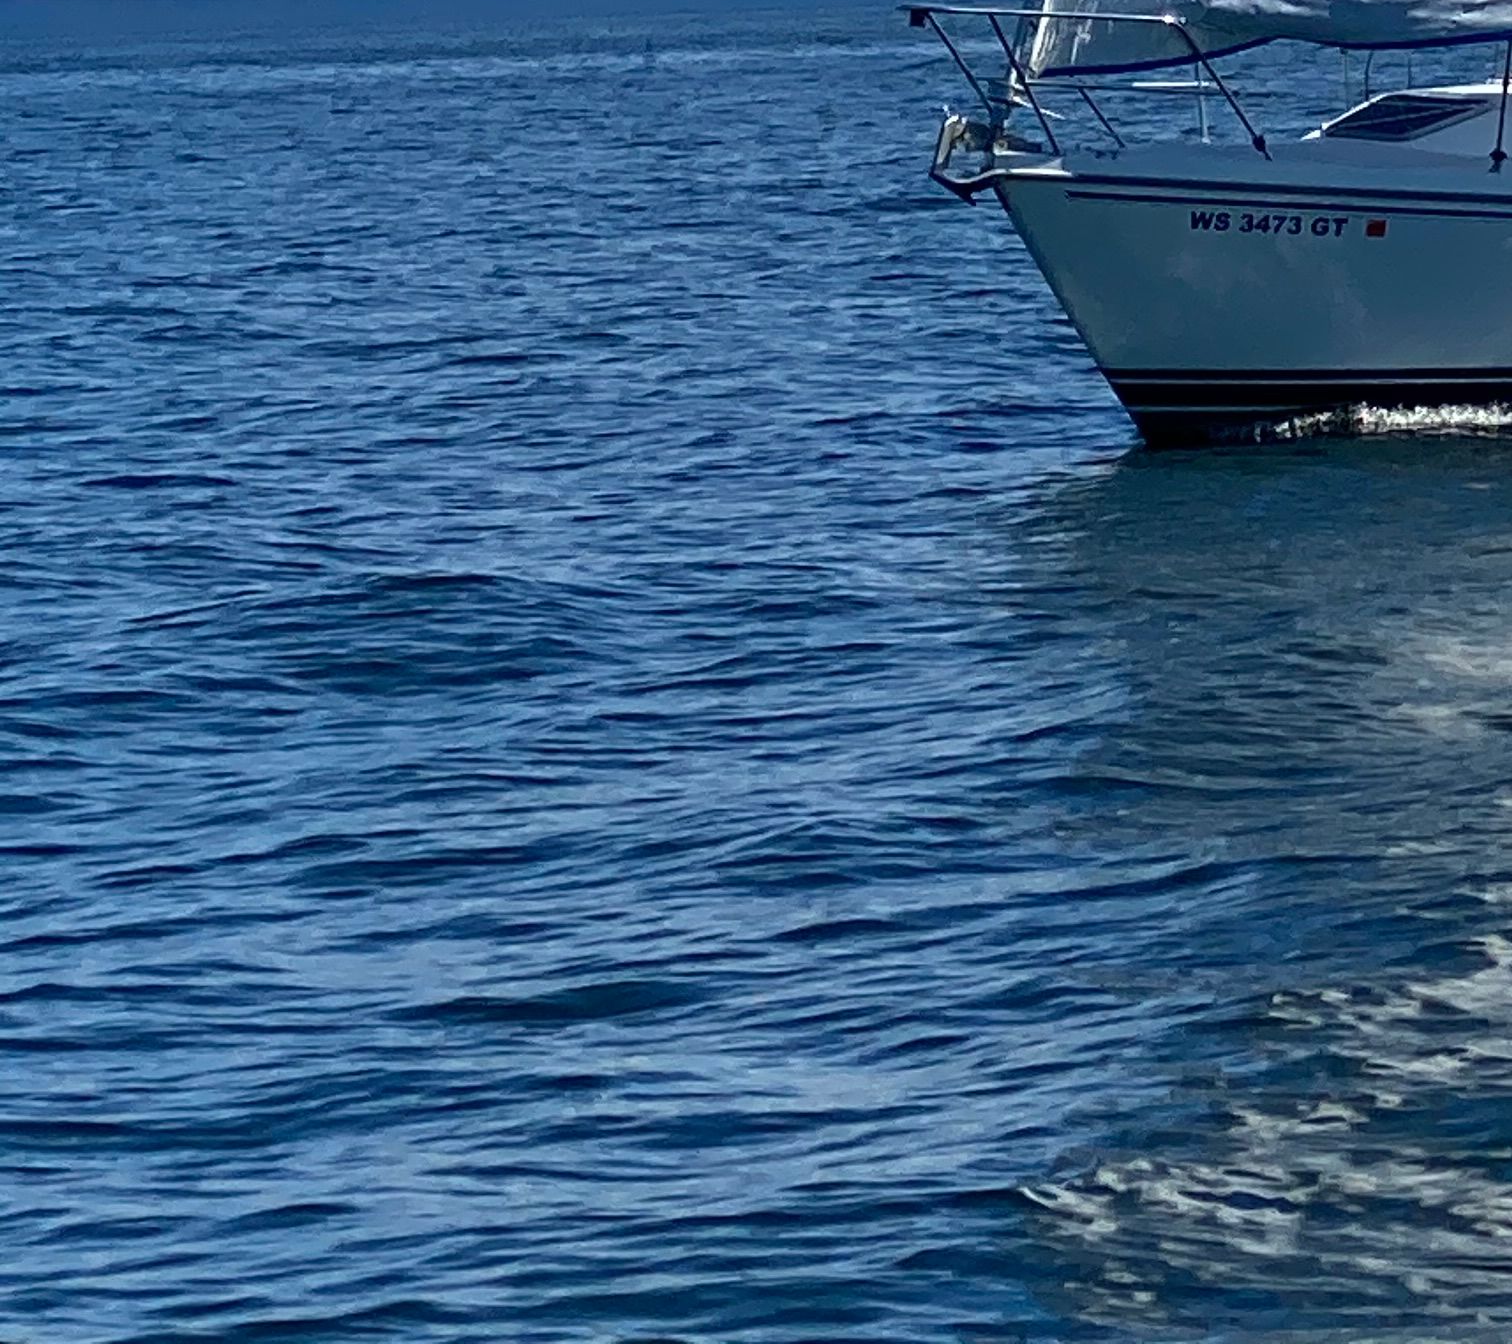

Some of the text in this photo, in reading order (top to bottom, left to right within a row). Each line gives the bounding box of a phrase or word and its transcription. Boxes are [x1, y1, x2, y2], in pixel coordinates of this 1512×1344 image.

[1190, 210, 1349, 238] WS 3473 GT
